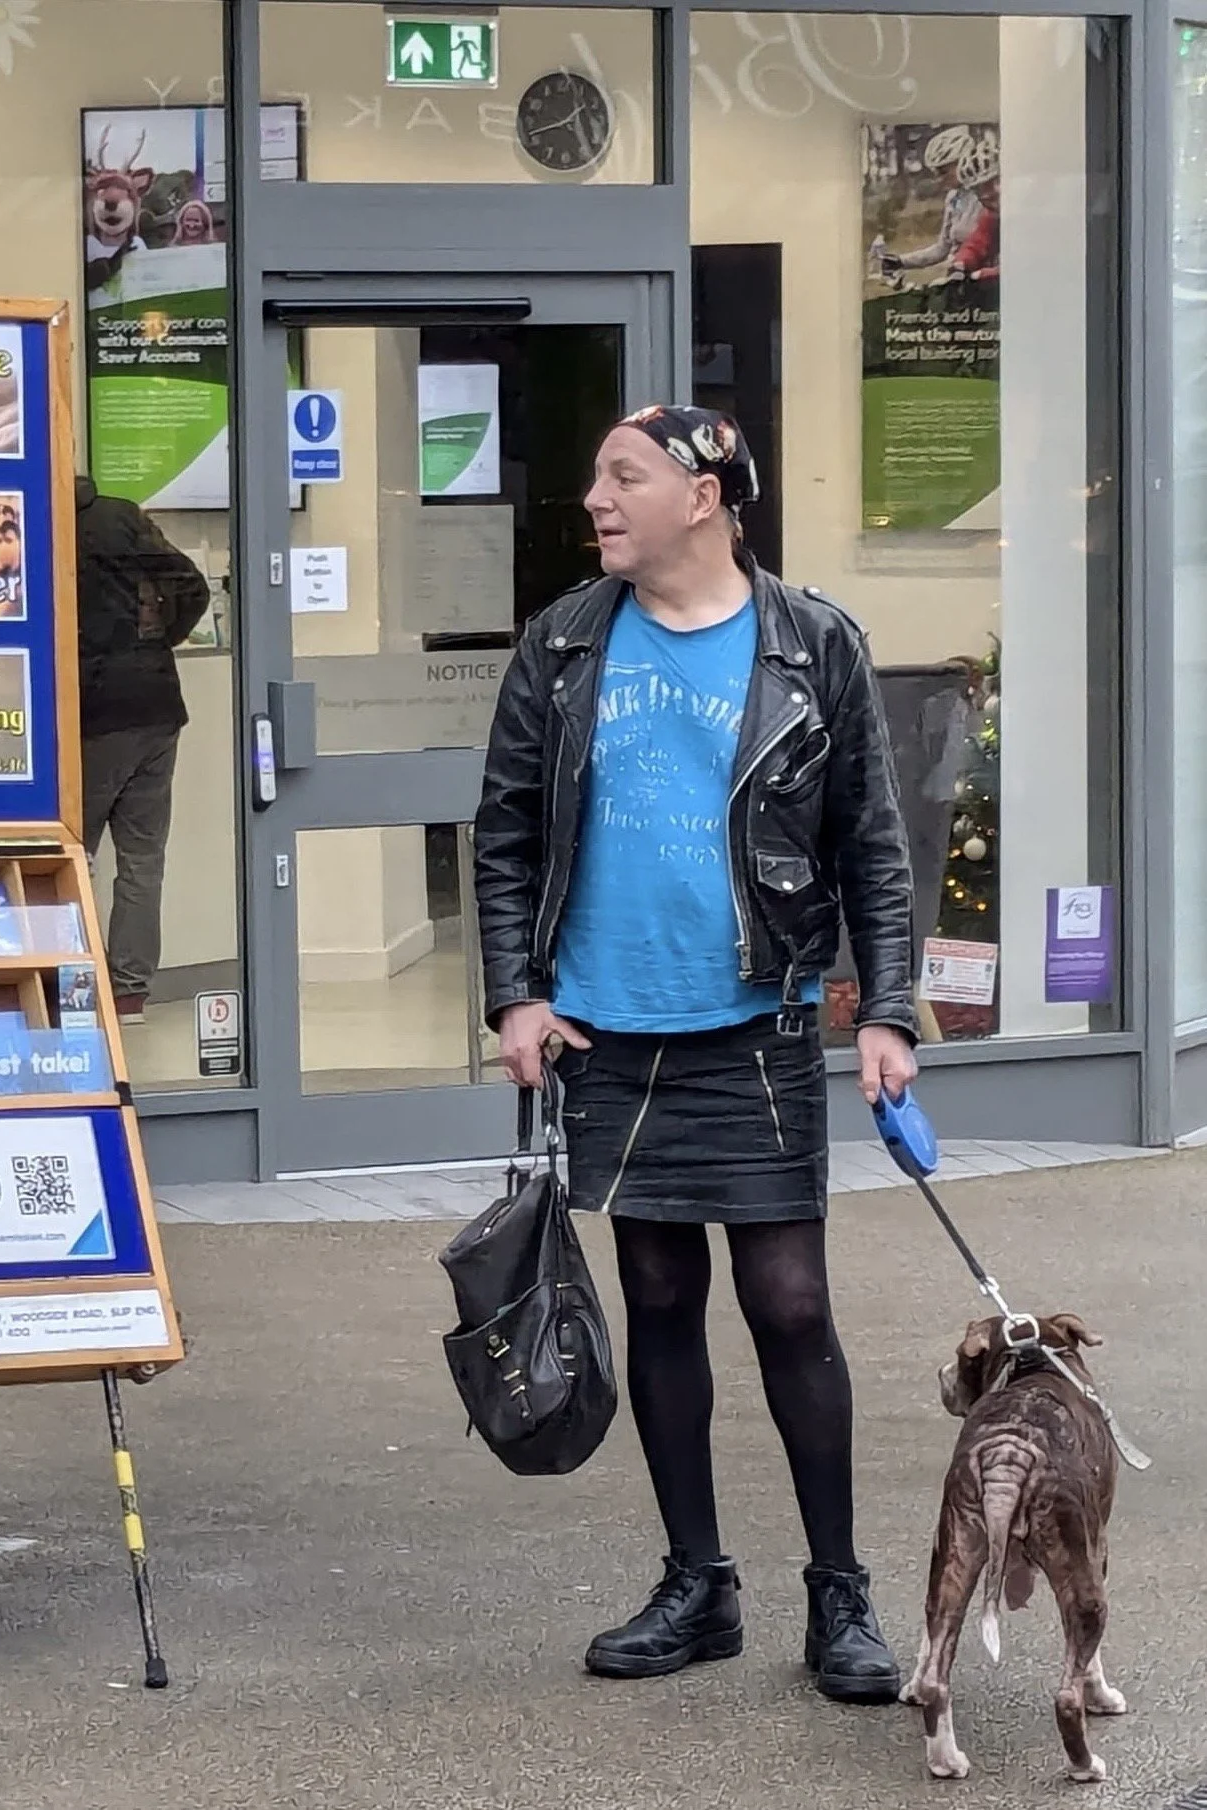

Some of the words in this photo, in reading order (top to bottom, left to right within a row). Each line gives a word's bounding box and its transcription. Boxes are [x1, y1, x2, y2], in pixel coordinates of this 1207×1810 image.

[885, 309, 938, 324] Friends
[942, 308, 970, 322] and
[973, 308, 1000, 322] fam
[163, 318, 192, 332] your
[197, 317, 227, 329] com
[98, 333, 128, 347] with
[130, 335, 152, 346] our
[157, 332, 229, 346] Communit
[886, 328, 923, 342] Meet
[926, 328, 951, 341] the
[98, 350, 137, 364] Saver
[139, 350, 201, 364] Accounts
[885, 345, 917, 360] local
[920, 345, 975, 364] building
[307, 554, 327, 562] Push
[304, 568, 332, 577] Button
[427, 663, 498, 682] NOTICE
[30, 1050, 90, 1075] take!
[11, 1312, 68, 1323] WOODSIDE
[111, 1307, 131, 1317] SLIP
